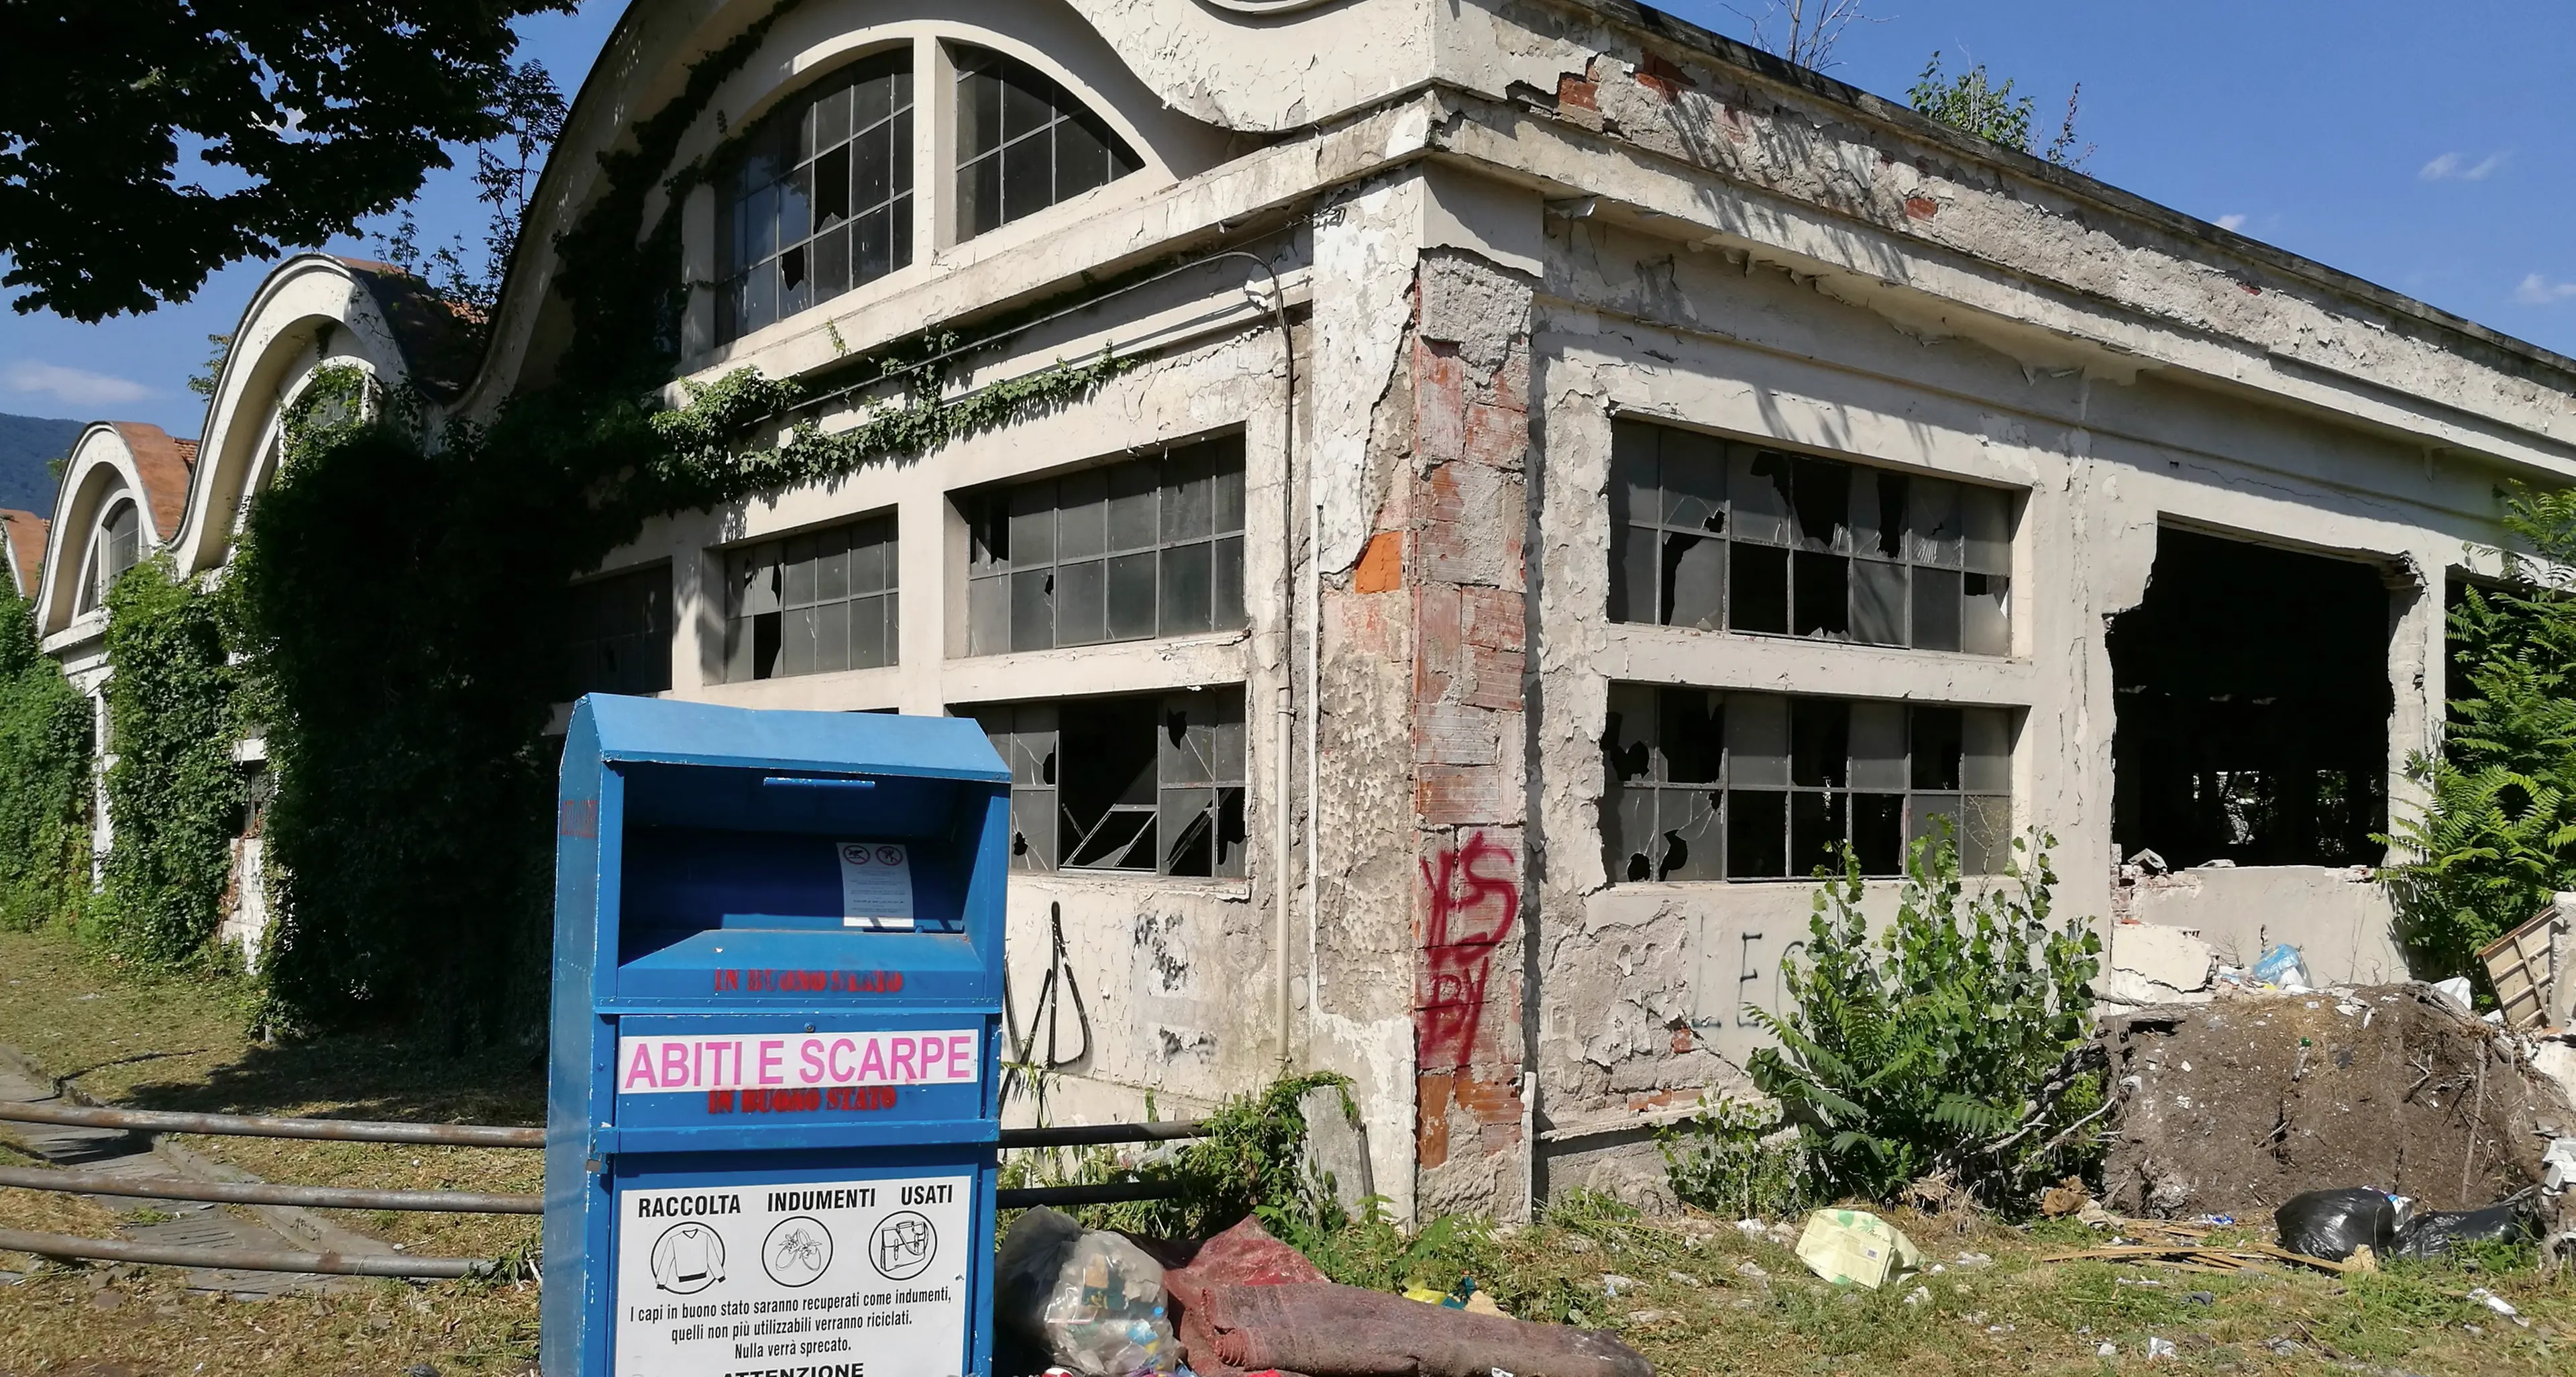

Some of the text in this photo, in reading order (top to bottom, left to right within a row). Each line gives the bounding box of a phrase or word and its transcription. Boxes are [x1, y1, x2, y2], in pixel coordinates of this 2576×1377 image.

[625, 1035, 971, 1089] ABITI E SCARPE
[638, 1184, 953, 1217] RACCOLTA INDUMENTI USATI
[638, 1304, 663, 1324] capi
[667, 1304, 678, 1319] in
[682, 1303, 716, 1319] buono
[720, 1300, 749, 1316] stato
[753, 1298, 798, 1313] saranno
[802, 1292, 859, 1312] recuperati
[863, 1293, 892, 1307] come
[896, 1286, 951, 1303] indumenti,
[672, 1310, 912, 1345] quelli non più utilizzabili verranno riciclati.
[735, 1337, 851, 1359] Nulla verrà sprecato.
[724, 1362, 864, 1377] ENZIONE
